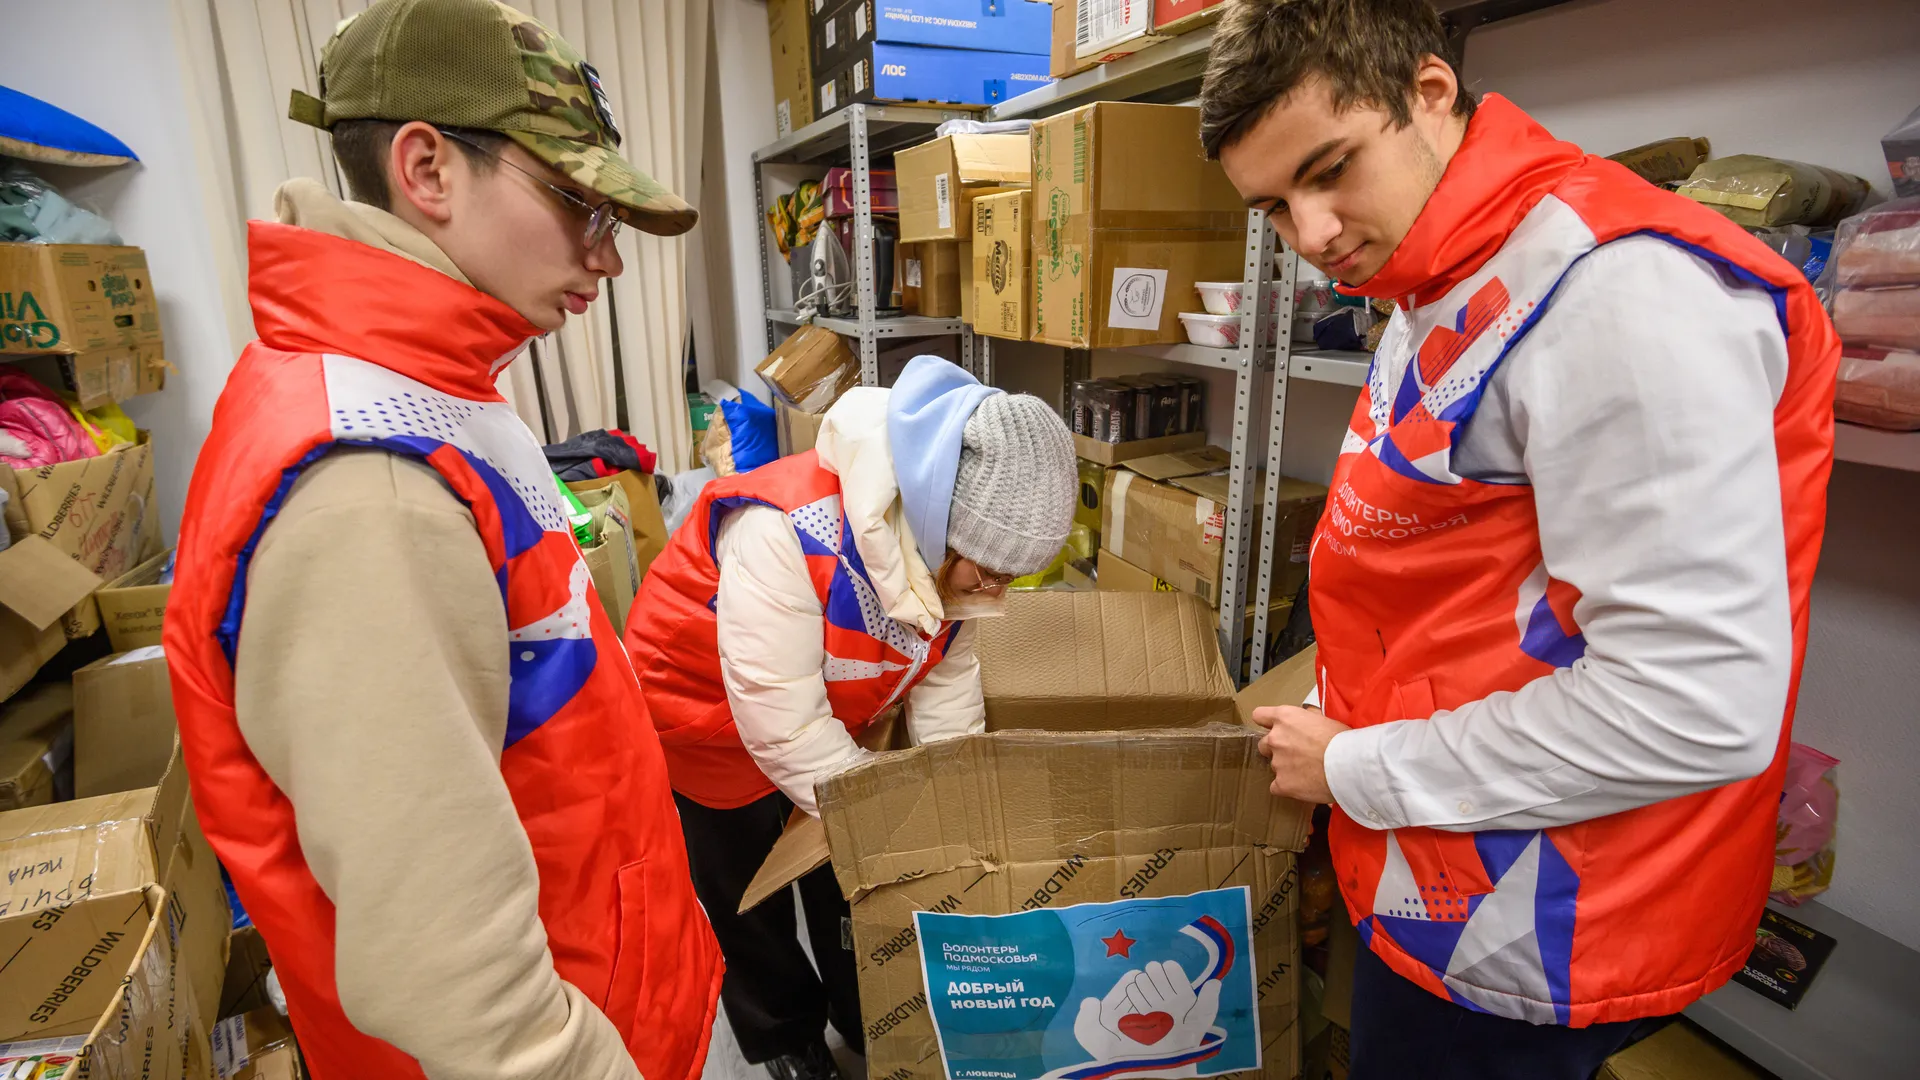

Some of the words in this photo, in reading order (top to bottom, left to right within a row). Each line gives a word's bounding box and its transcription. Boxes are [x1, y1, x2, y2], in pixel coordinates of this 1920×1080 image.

[884, 12, 910, 21] Monitor
[911, 14, 924, 23] LCD
[881, 64, 907, 77] AOC
[0, 321, 61, 349] Glo
[942, 942, 1018, 954] ВОЛОНТЕРЫ
[943, 952, 1037, 964] ПОДМОСКОВЬЯ
[30, 930, 125, 1024] WILDBERRIES
[947, 979, 1025, 996] ДОБРЫЙ
[950, 996, 1016, 1009] НОВЫЙ
[1021, 996, 1056, 1008] ГОД
[966, 1071, 1016, 1079] ЛЮБЕРЦЫ
